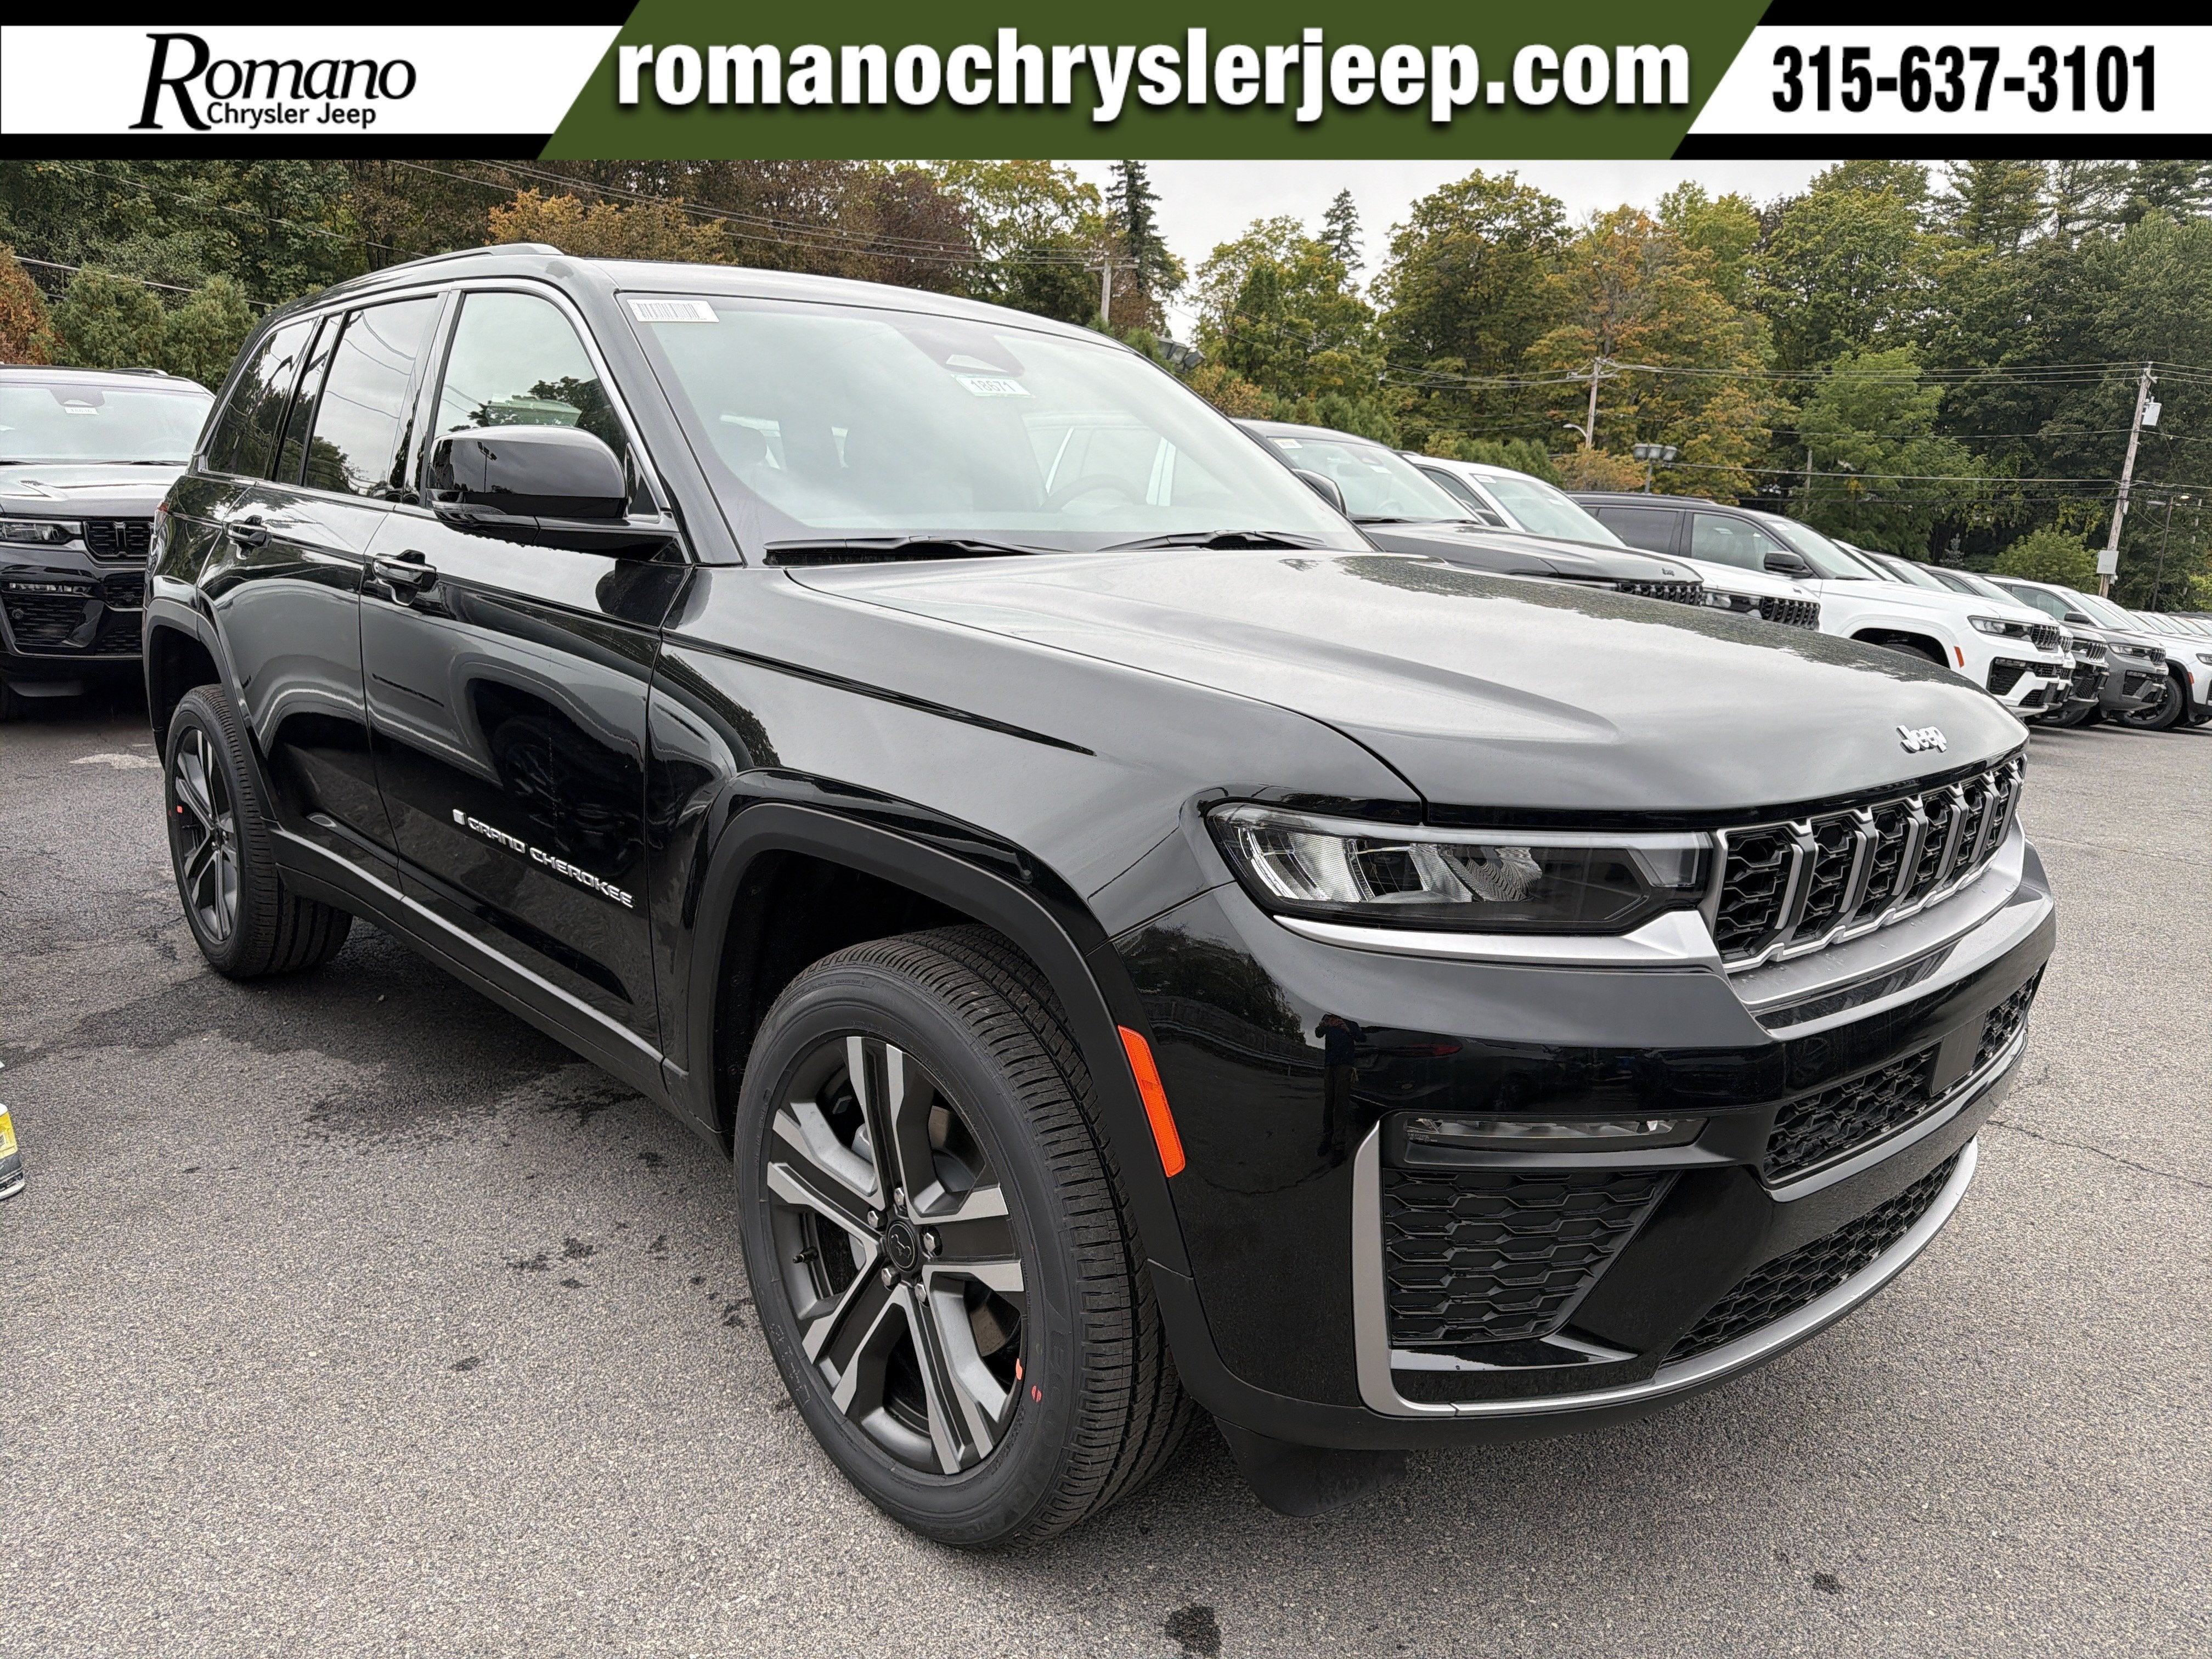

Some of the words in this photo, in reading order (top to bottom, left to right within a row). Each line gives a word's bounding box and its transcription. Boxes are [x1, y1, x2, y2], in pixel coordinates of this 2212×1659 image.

[970, 380, 1016, 392] 18671
[1896, 725, 1948, 754] Jeep
[467, 816, 527, 854] GRAND
[529, 847, 635, 909] CHEROKEE
